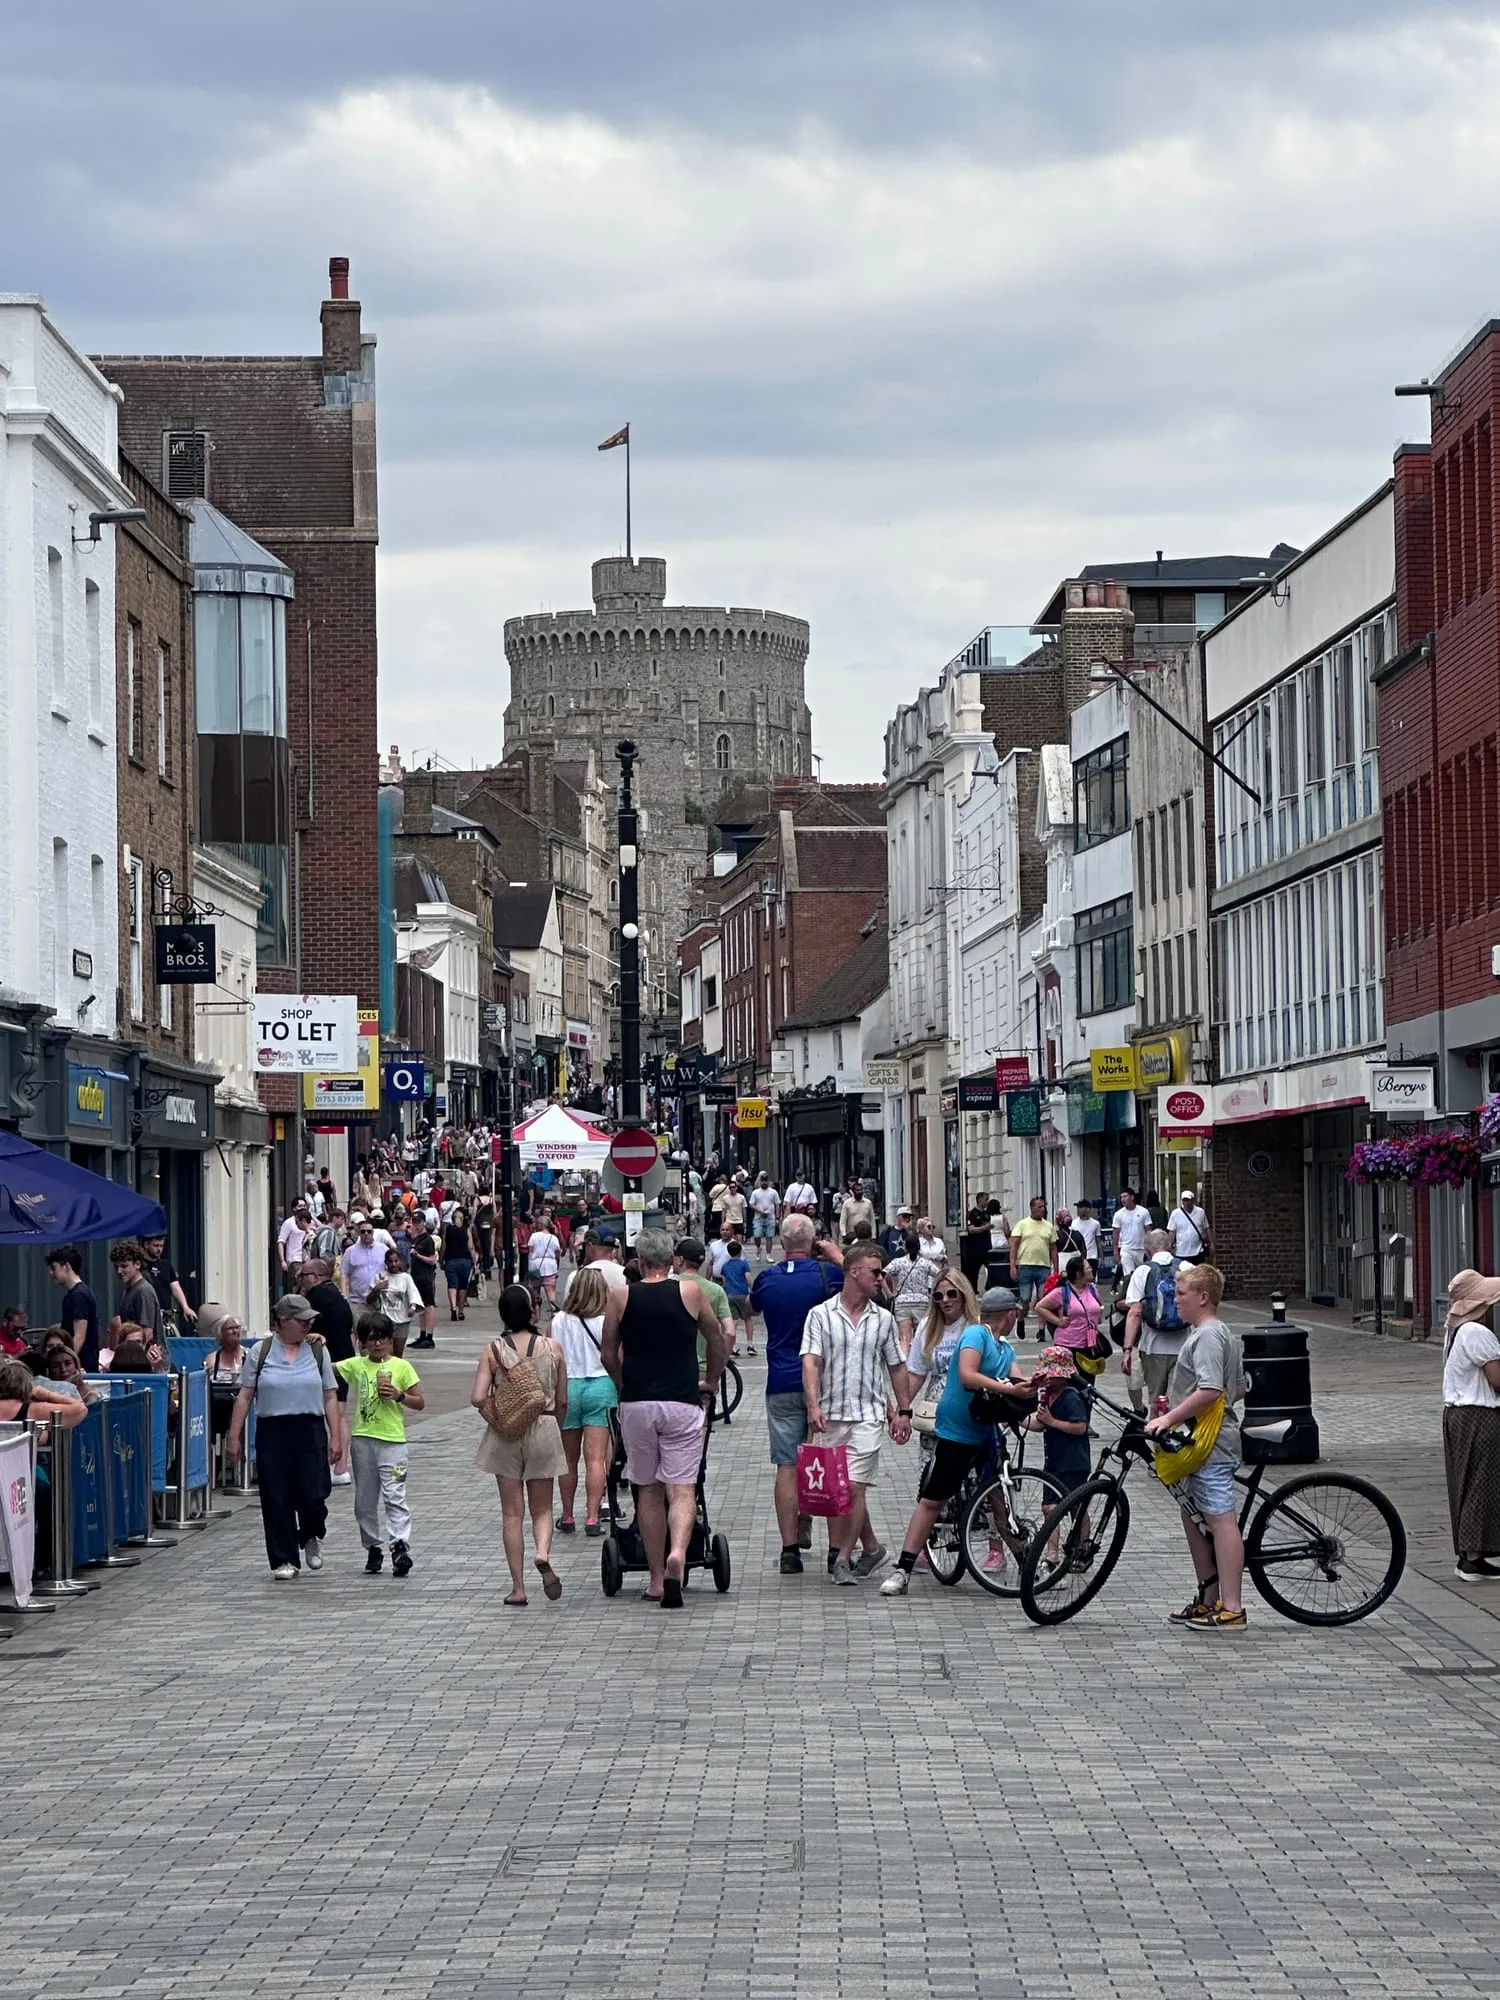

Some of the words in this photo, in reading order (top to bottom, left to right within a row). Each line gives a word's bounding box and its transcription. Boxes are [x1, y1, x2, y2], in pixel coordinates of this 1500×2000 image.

[166, 942, 204, 953] MS
[166, 955, 208, 965] BROS.
[280, 1009, 313, 1019] SHOP
[258, 1021, 290, 1041] TO
[297, 1022, 337, 1041] LET
[1104, 1055, 1123, 1064] The
[679, 1067, 695, 1080] W
[867, 1069, 891, 1077] GIFTS
[1098, 1065, 1130, 1075] Works
[661, 1074, 676, 1087] W
[869, 1077, 899, 1085] CARDS
[1175, 1097, 1197, 1105] POST
[741, 1106, 763, 1119] itsu
[1170, 1105, 1200, 1113] OFFICE
[536, 1143, 578, 1151] WINDSOR
